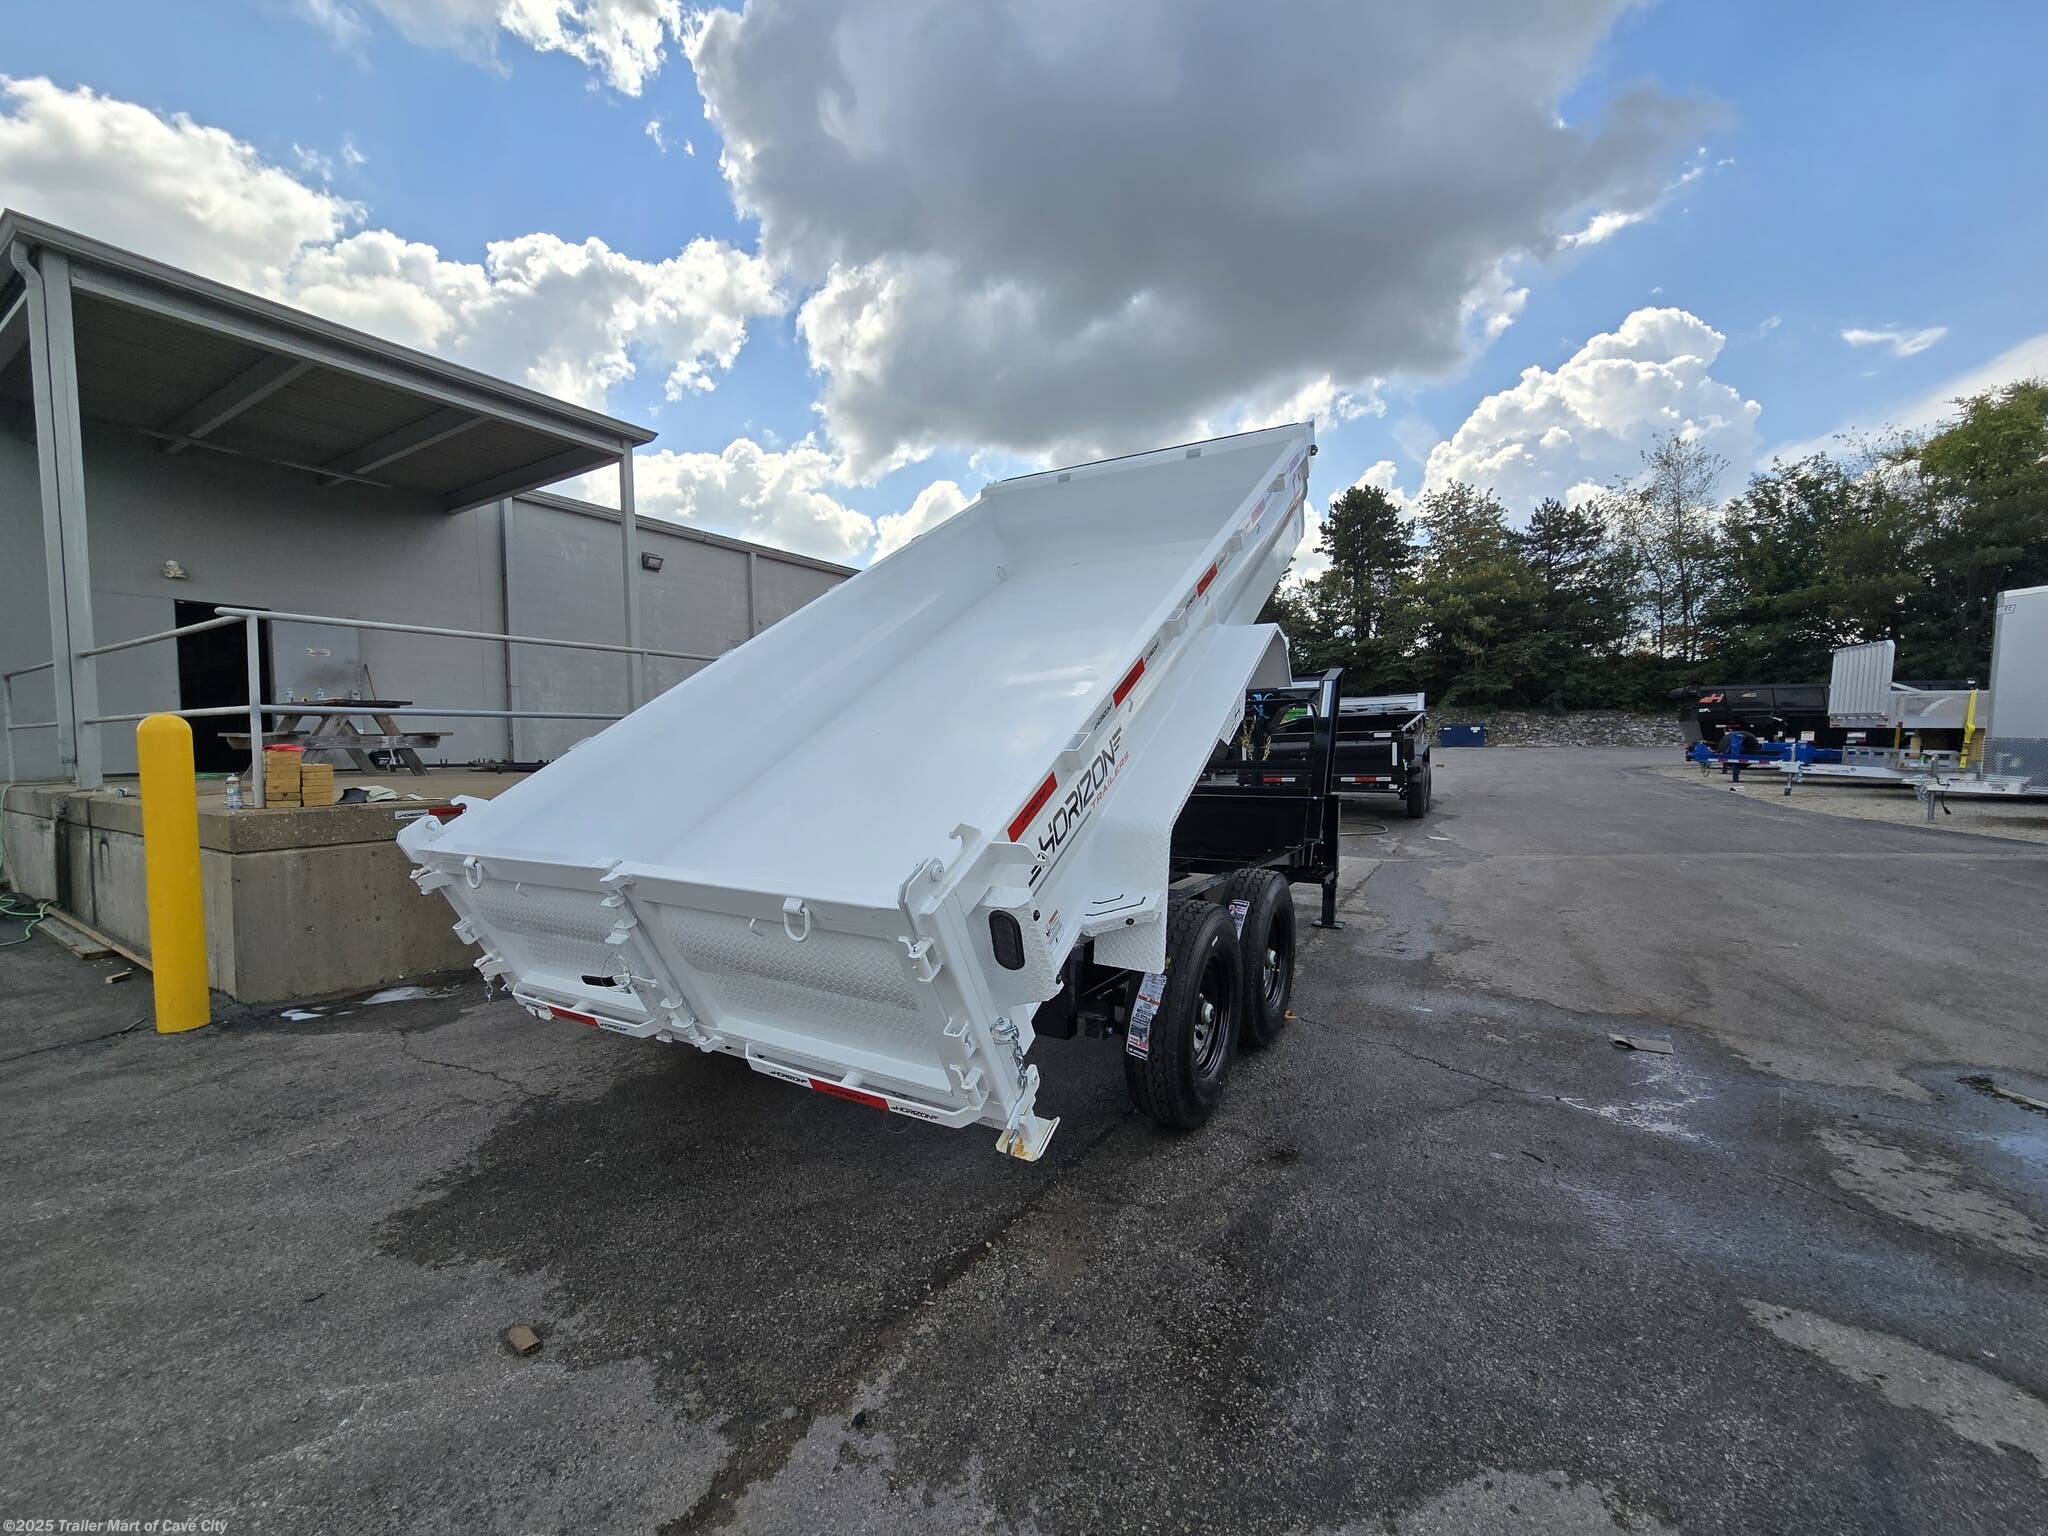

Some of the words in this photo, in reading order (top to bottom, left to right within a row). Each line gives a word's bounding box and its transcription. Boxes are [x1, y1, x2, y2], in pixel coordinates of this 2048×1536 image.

[1037, 727, 1122, 856] HORIZON
[1090, 751, 1130, 810] TRAILERS
[890, 1104, 940, 1121] HORIZON
